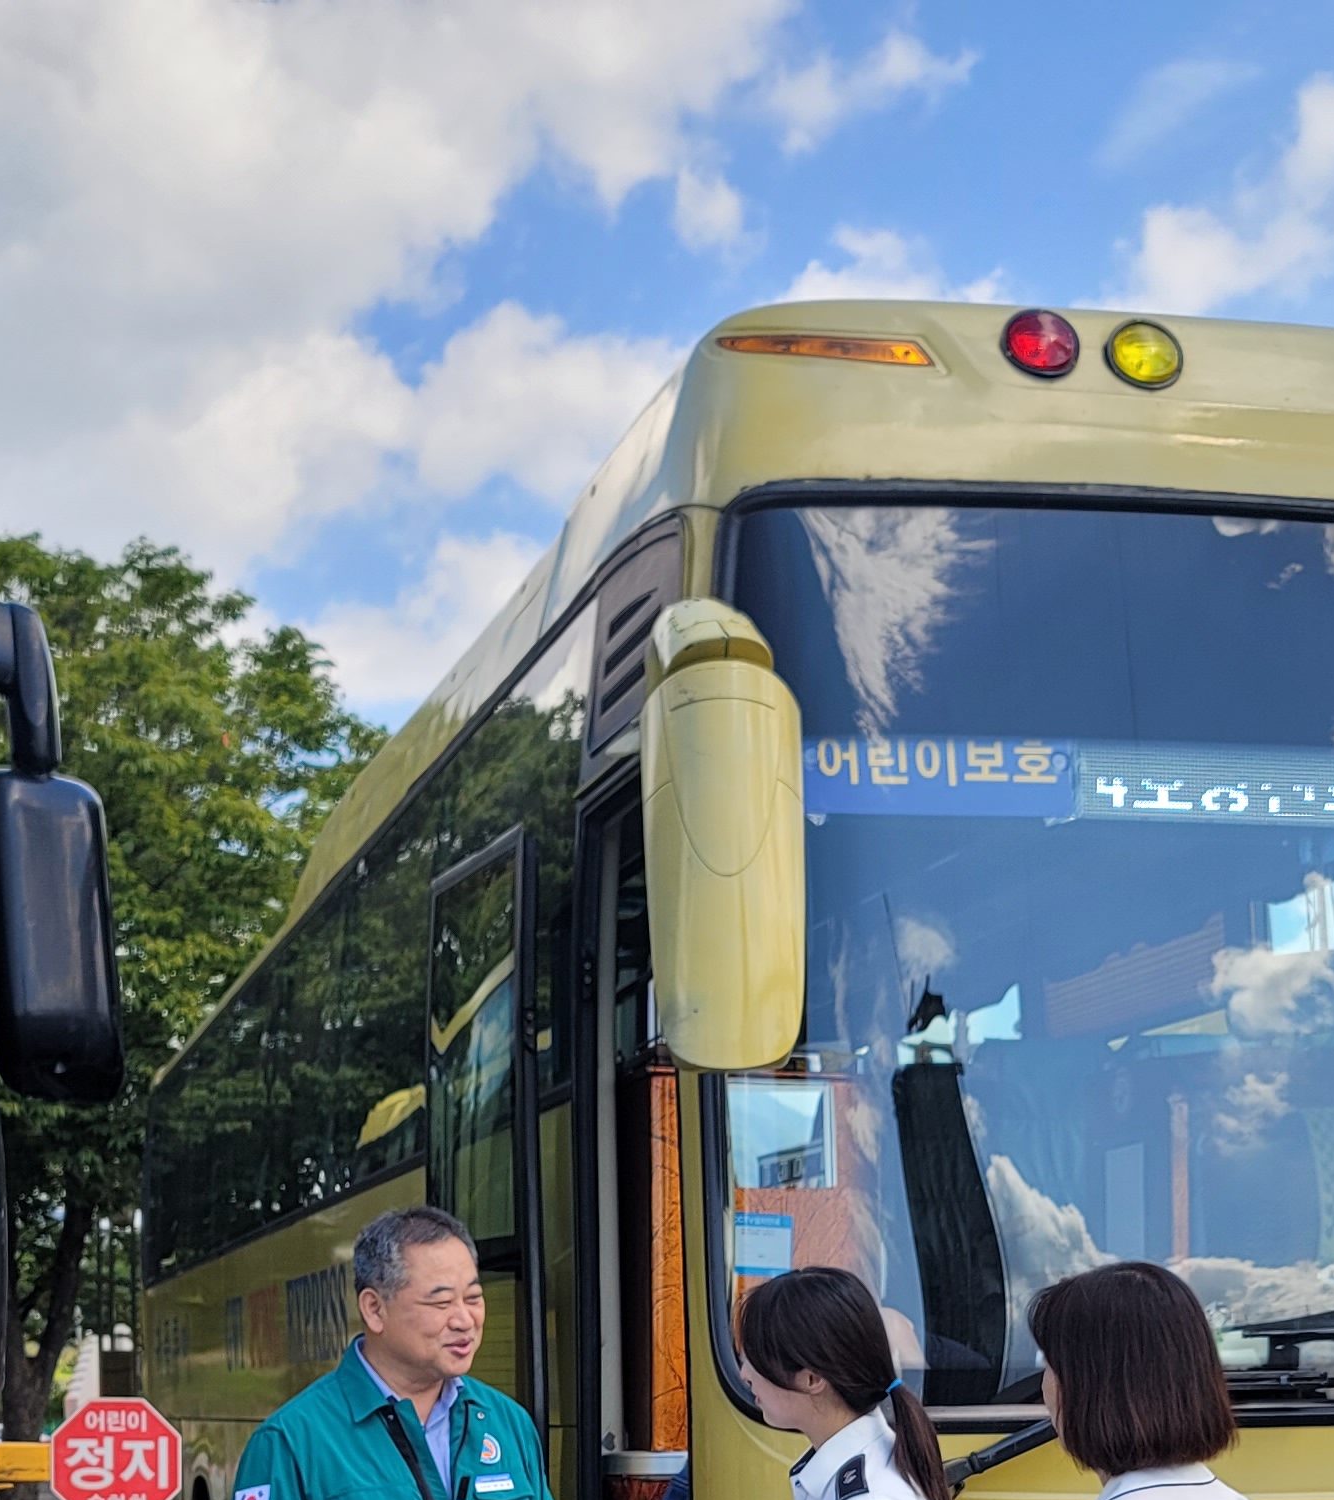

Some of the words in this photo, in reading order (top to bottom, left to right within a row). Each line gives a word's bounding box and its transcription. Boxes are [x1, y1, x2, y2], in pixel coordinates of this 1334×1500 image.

[818, 738, 1058, 787] 어린이보호
[84, 1409, 147, 1433] 어린이
[64, 1435, 169, 1491] 정지
